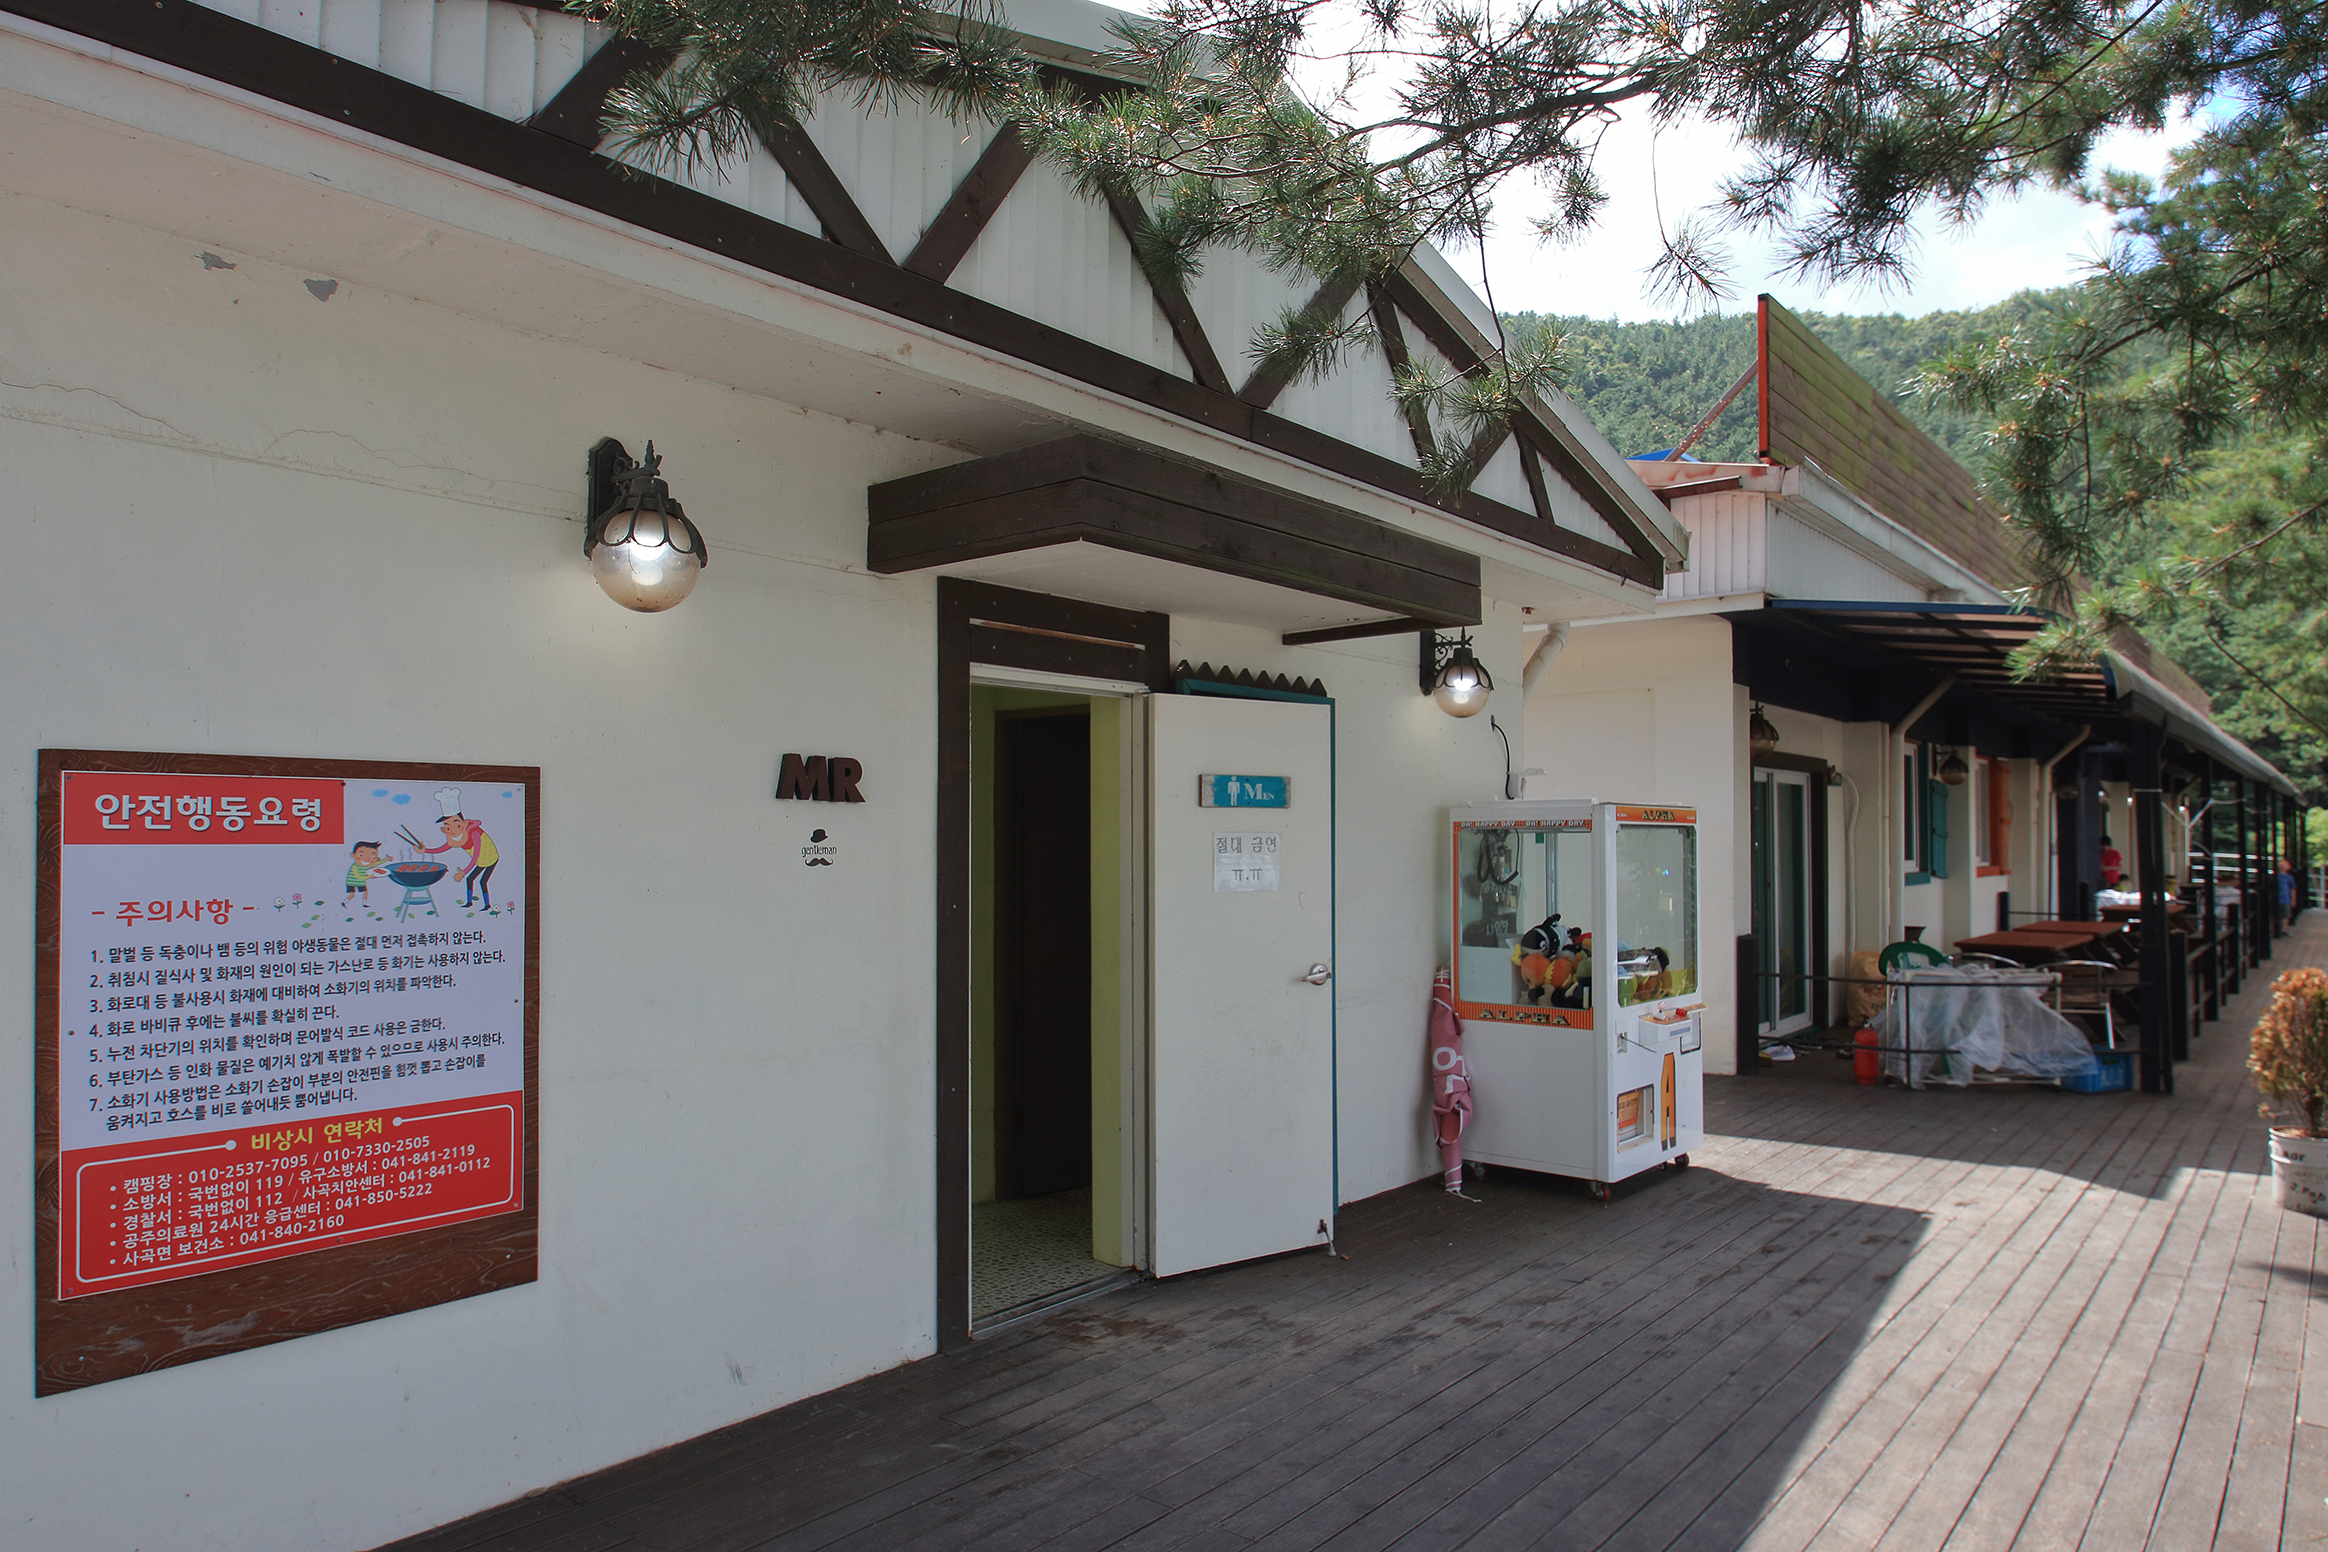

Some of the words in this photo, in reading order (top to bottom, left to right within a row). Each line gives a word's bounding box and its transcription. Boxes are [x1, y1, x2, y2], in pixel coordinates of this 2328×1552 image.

[775, 752, 866, 803] MR
[94, 794, 322, 833] 안전행동요령
[1642, 810, 1675, 821] ALPHA
[801, 845, 837, 858] gentleman
[1216, 837, 1242, 854] 절대
[1251, 836, 1277, 854] 금연
[116, 898, 233, 927] 주의사항
[91, 949, 104, 963] 1.
[109, 947, 137, 964] 말벌
[140, 946, 155, 962] 등
[158, 943, 213, 961] 독충이나
[217, 943, 230, 958] 뱀
[234, 941, 259, 956] 등의
[263, 939, 288, 955] 위험
[292, 937, 351, 953] 야생동물은
[354, 935, 378, 950] 절대
[381, 934, 403, 948] 먼저
[406, 932, 449, 947] 접촉하지
[452, 930, 486, 945] 않는다.
[89, 974, 103, 988] 2.
[108, 970, 150, 987] 취침시
[155, 968, 196, 985] 질식사
[200, 967, 212, 983] 및
[216, 964, 255, 981] 화재의
[259, 962, 297, 979] 원인이
[300, 961, 325, 976] 되는
[328, 958, 374, 974] 가스난로
[377, 957, 389, 971] 등
[391, 955, 425, 970] 화기는
[428, 952, 470, 967] 사용하지
[473, 950, 506, 965] 않는다.
[89, 1000, 103, 1013] 3.
[107, 995, 150, 1012] 화로대
[154, 993, 168, 1009] 등
[172, 990, 225, 1008] 불사용시
[229, 987, 268, 1003] 화재에
[272, 983, 320, 1001] 대비하여
[324, 979, 370, 996] 소화기의
[374, 977, 407, 993] 위치를
[410, 974, 456, 990] 파악한다.
[89, 1024, 103, 1038] 4.
[107, 1020, 135, 1037] 화로
[140, 1017, 182, 1035] 바비큐
[185, 1014, 226, 1031] 후에는
[230, 1010, 268, 1027] 불씨를
[272, 1007, 308, 1024] 확실히
[312, 1005, 339, 1021] 끈다.
[1478, 1009, 1571, 1026] ALPHA
[89, 1049, 103, 1063] 5.
[107, 1044, 136, 1062] 누전
[140, 1039, 195, 1059] 차단기의
[199, 1035, 238, 1052] 위치를
[242, 1031, 293, 1049] 확인하며
[296, 1026, 344, 1045] 문어발식
[347, 1024, 370, 1038] 코드
[373, 1020, 407, 1036] 사용은
[410, 1017, 445, 1033] 금한다.
[89, 1074, 103, 1088] 6.
[107, 1067, 164, 1087] 부탄가스
[167, 1065, 181, 1081] 등
[185, 1062, 213, 1079] 인화
[216, 1058, 255, 1076] 물질은
[259, 1054, 296, 1071] 예기치
[300, 1051, 324, 1067] 않게
[327, 1048, 362, 1064] 폭발할
[365, 1046, 377, 1060] 수
[380, 1041, 424, 1058] 있으므로
[427, 1037, 459, 1052] 사용시
[462, 1032, 505, 1048] 주의한다.
[89, 1099, 103, 1112] 7.
[107, 1092, 149, 1110] 소화기
[154, 1084, 221, 1106] 사용방법은
[225, 1079, 264, 1097] 소화기
[267, 1075, 304, 1093] 손잡이
[308, 1070, 343, 1088] 부분의
[347, 1065, 392, 1083] 안전핀을
[396, 1062, 418, 1078] 힘껏
[420, 1060, 442, 1075] 뽑고
[445, 1053, 486, 1071] 손잡이를
[106, 1110, 163, 1131] 움켜지고
[166, 1104, 207, 1122] 호스를
[211, 1101, 237, 1118] 비로
[241, 1095, 291, 1115] 쓸어내듯
[295, 1087, 357, 1108] 뿜어냅니다.
[251, 1127, 313, 1151] 비상시
[324, 1117, 383, 1144] 연락처
[123, 1173, 173, 1195] 캠핑장
[189, 1154, 308, 1184] 010-2537-7095
[323, 1135, 430, 1163] 010-7330-2505
[123, 1191, 172, 1212] 소방서
[188, 1179, 250, 1202] 국번없이
[256, 1175, 284, 1191] 119
[299, 1160, 368, 1184] 유구소방서
[381, 1144, 475, 1170] 041-841-2119
[123, 1209, 172, 1231] 경찰서
[188, 1196, 250, 1220] 국번없이
[256, 1192, 283, 1208] 112
[303, 1173, 385, 1200] 사곡치안센터
[399, 1157, 490, 1183] 041-841-0112
[123, 1221, 204, 1250] 공주의료원
[210, 1212, 260, 1234] 24시간
[264, 1200, 321, 1225] 응급센터
[335, 1182, 433, 1211] 041-850-5222
[123, 1245, 172, 1267] 사곡면
[177, 1238, 225, 1257] 보건소
[240, 1214, 345, 1245] 041-840-2160
